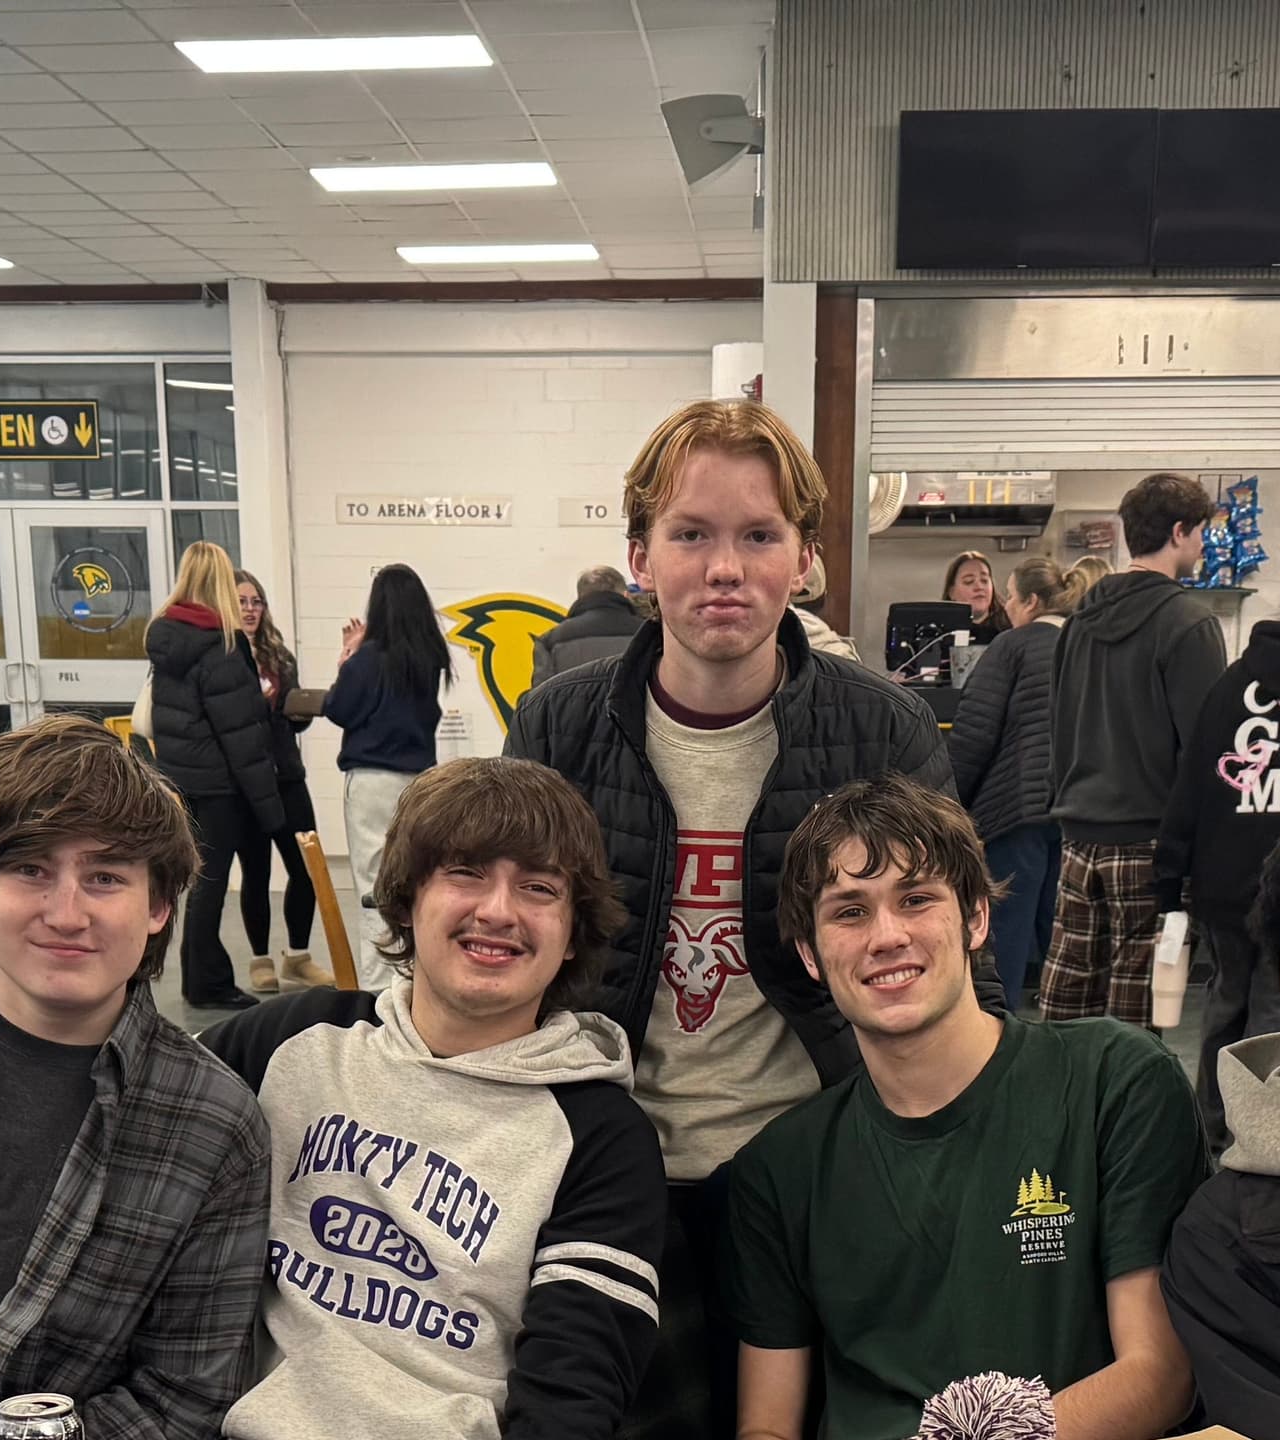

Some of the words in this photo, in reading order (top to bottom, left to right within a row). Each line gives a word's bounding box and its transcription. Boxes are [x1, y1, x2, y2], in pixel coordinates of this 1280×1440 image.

[347, 503, 368, 517] TO
[377, 503, 426, 517] ARENA
[435, 504, 491, 518] FLOOR
[584, 505, 607, 518] TO
[58, 672, 81, 682] PULL
[287, 1113, 418, 1190] MONTY
[411, 1150, 500, 1266] TECH
[1002, 1212, 1076, 1235] WHISPERING
[1021, 1228, 1063, 1242] PINES
[1020, 1240, 1065, 1252] RESERVE
[268, 1240, 480, 1350] BULLDOGS
